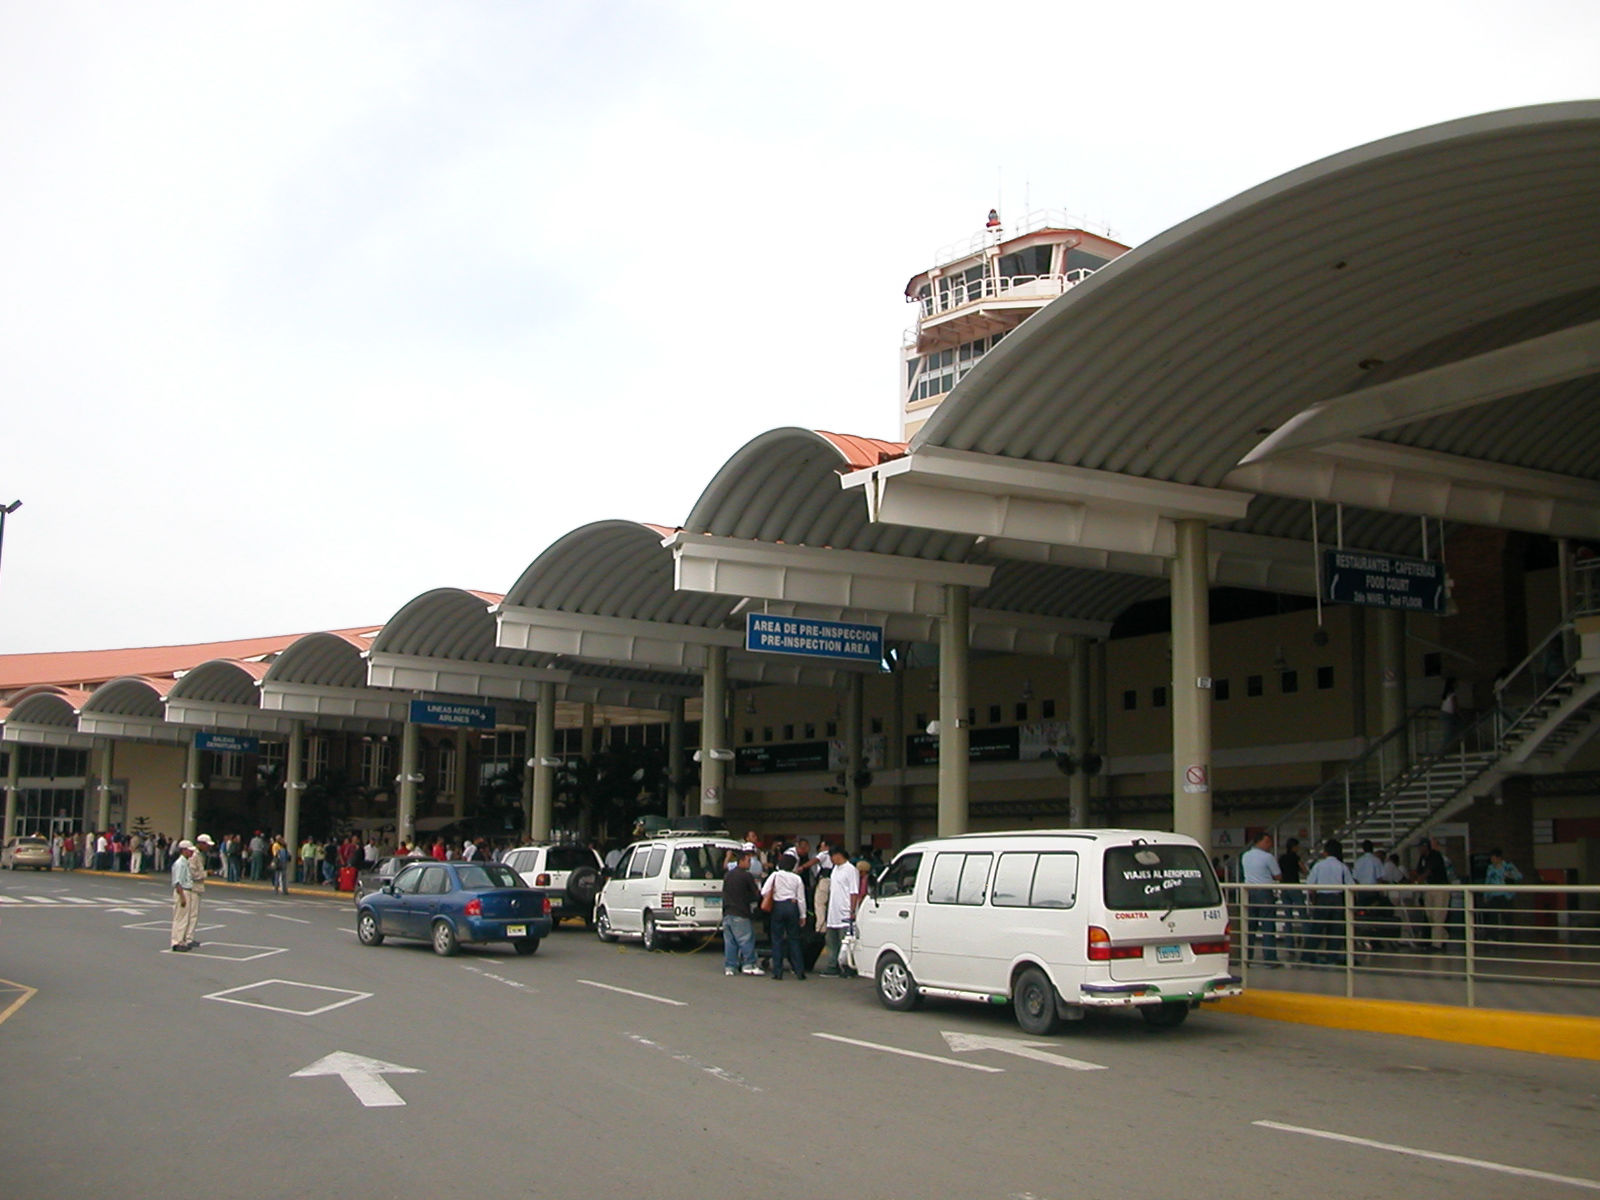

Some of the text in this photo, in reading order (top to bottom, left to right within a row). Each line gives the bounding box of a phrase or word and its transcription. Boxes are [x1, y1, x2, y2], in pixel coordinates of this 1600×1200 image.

[1336, 554, 1390, 573] RESTAURANTES
[1394, 561, 1436, 578] CAFETERIAS
[1365, 575, 1409, 591] FOOD COURT
[1402, 596, 1422, 608] FLOOR
[753, 620, 878, 642] AREA DE PRE-INSPECCION
[761, 634, 870, 654] PRE-INSPECTION AREA
[427, 704, 480, 716] LINEAS AEREAS
[438, 713, 470, 723] AIRLINES
[1123, 869, 1202, 880] VIAJES AL AEROPUERTO
[674, 906, 696, 917] 046
[1115, 911, 1149, 920] CONATRA
